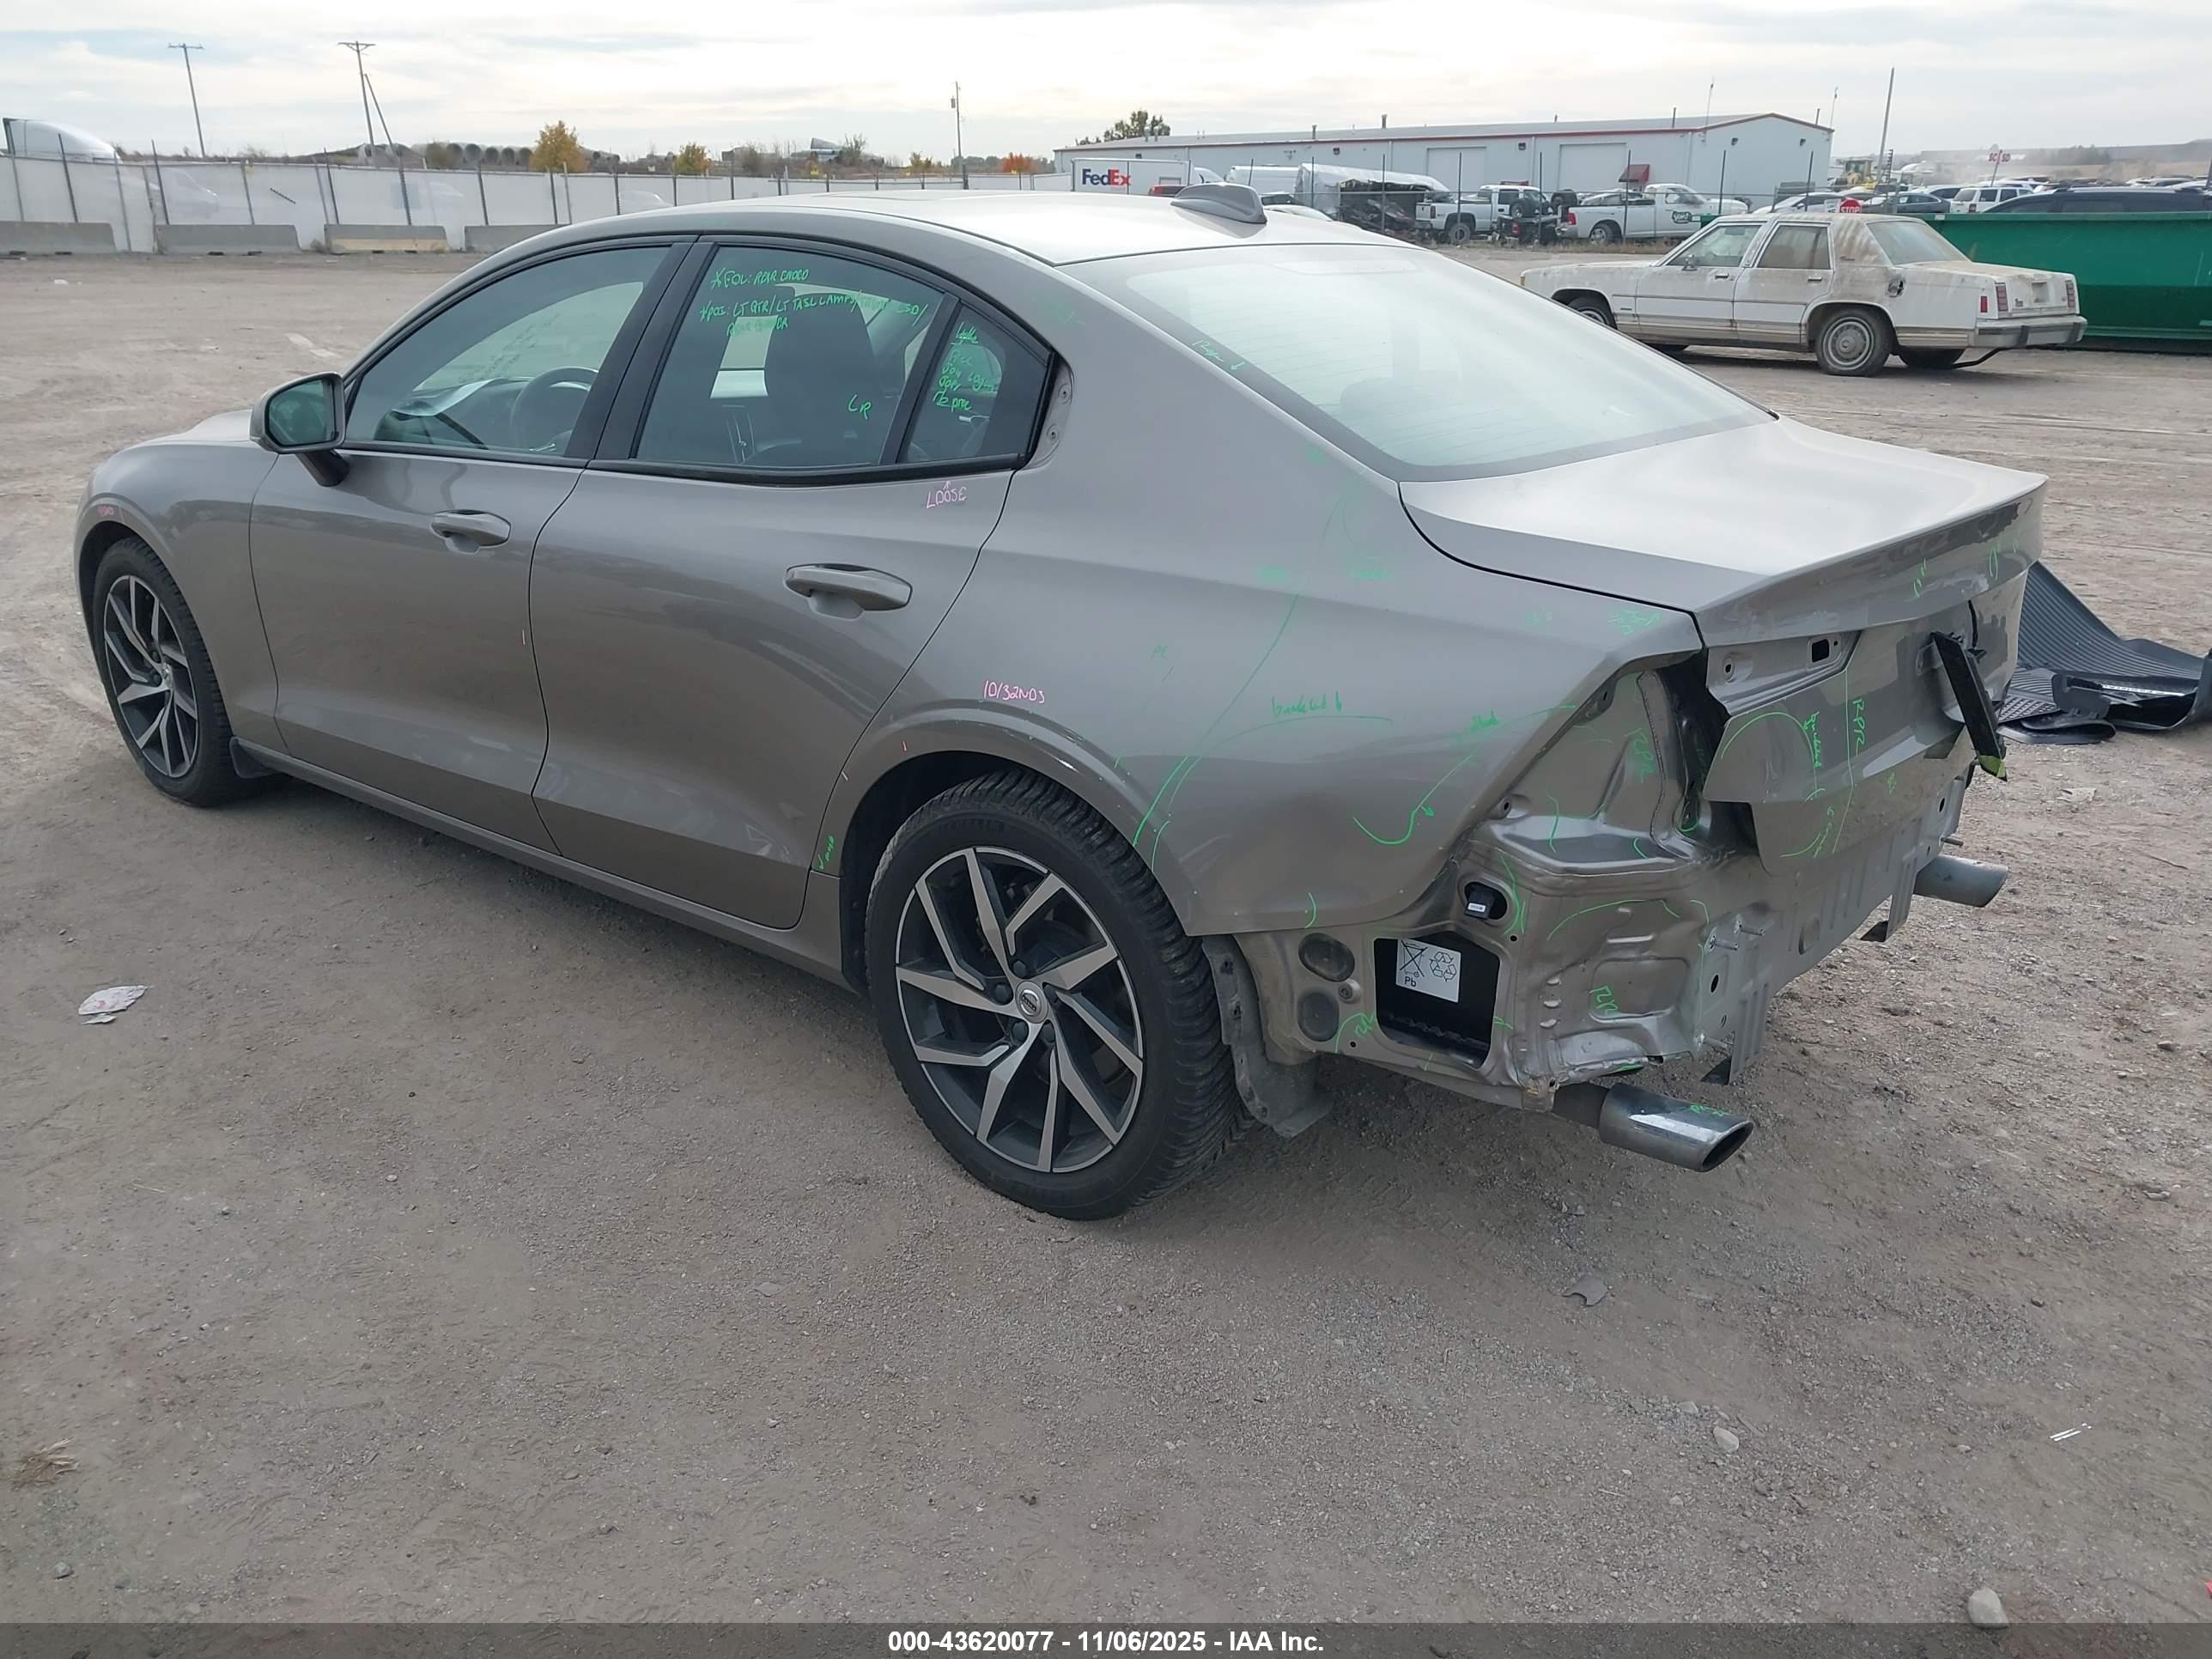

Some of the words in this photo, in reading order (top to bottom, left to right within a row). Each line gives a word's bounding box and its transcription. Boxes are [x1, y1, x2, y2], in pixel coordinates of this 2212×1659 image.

[1082, 168, 1132, 186] FedEx
[1840, 205, 1860, 214] STOP
[733, 301, 749, 317] LT
[848, 393, 872, 420] LR
[926, 486, 969, 509] LOOSE
[1404, 975, 1417, 988] Pb
